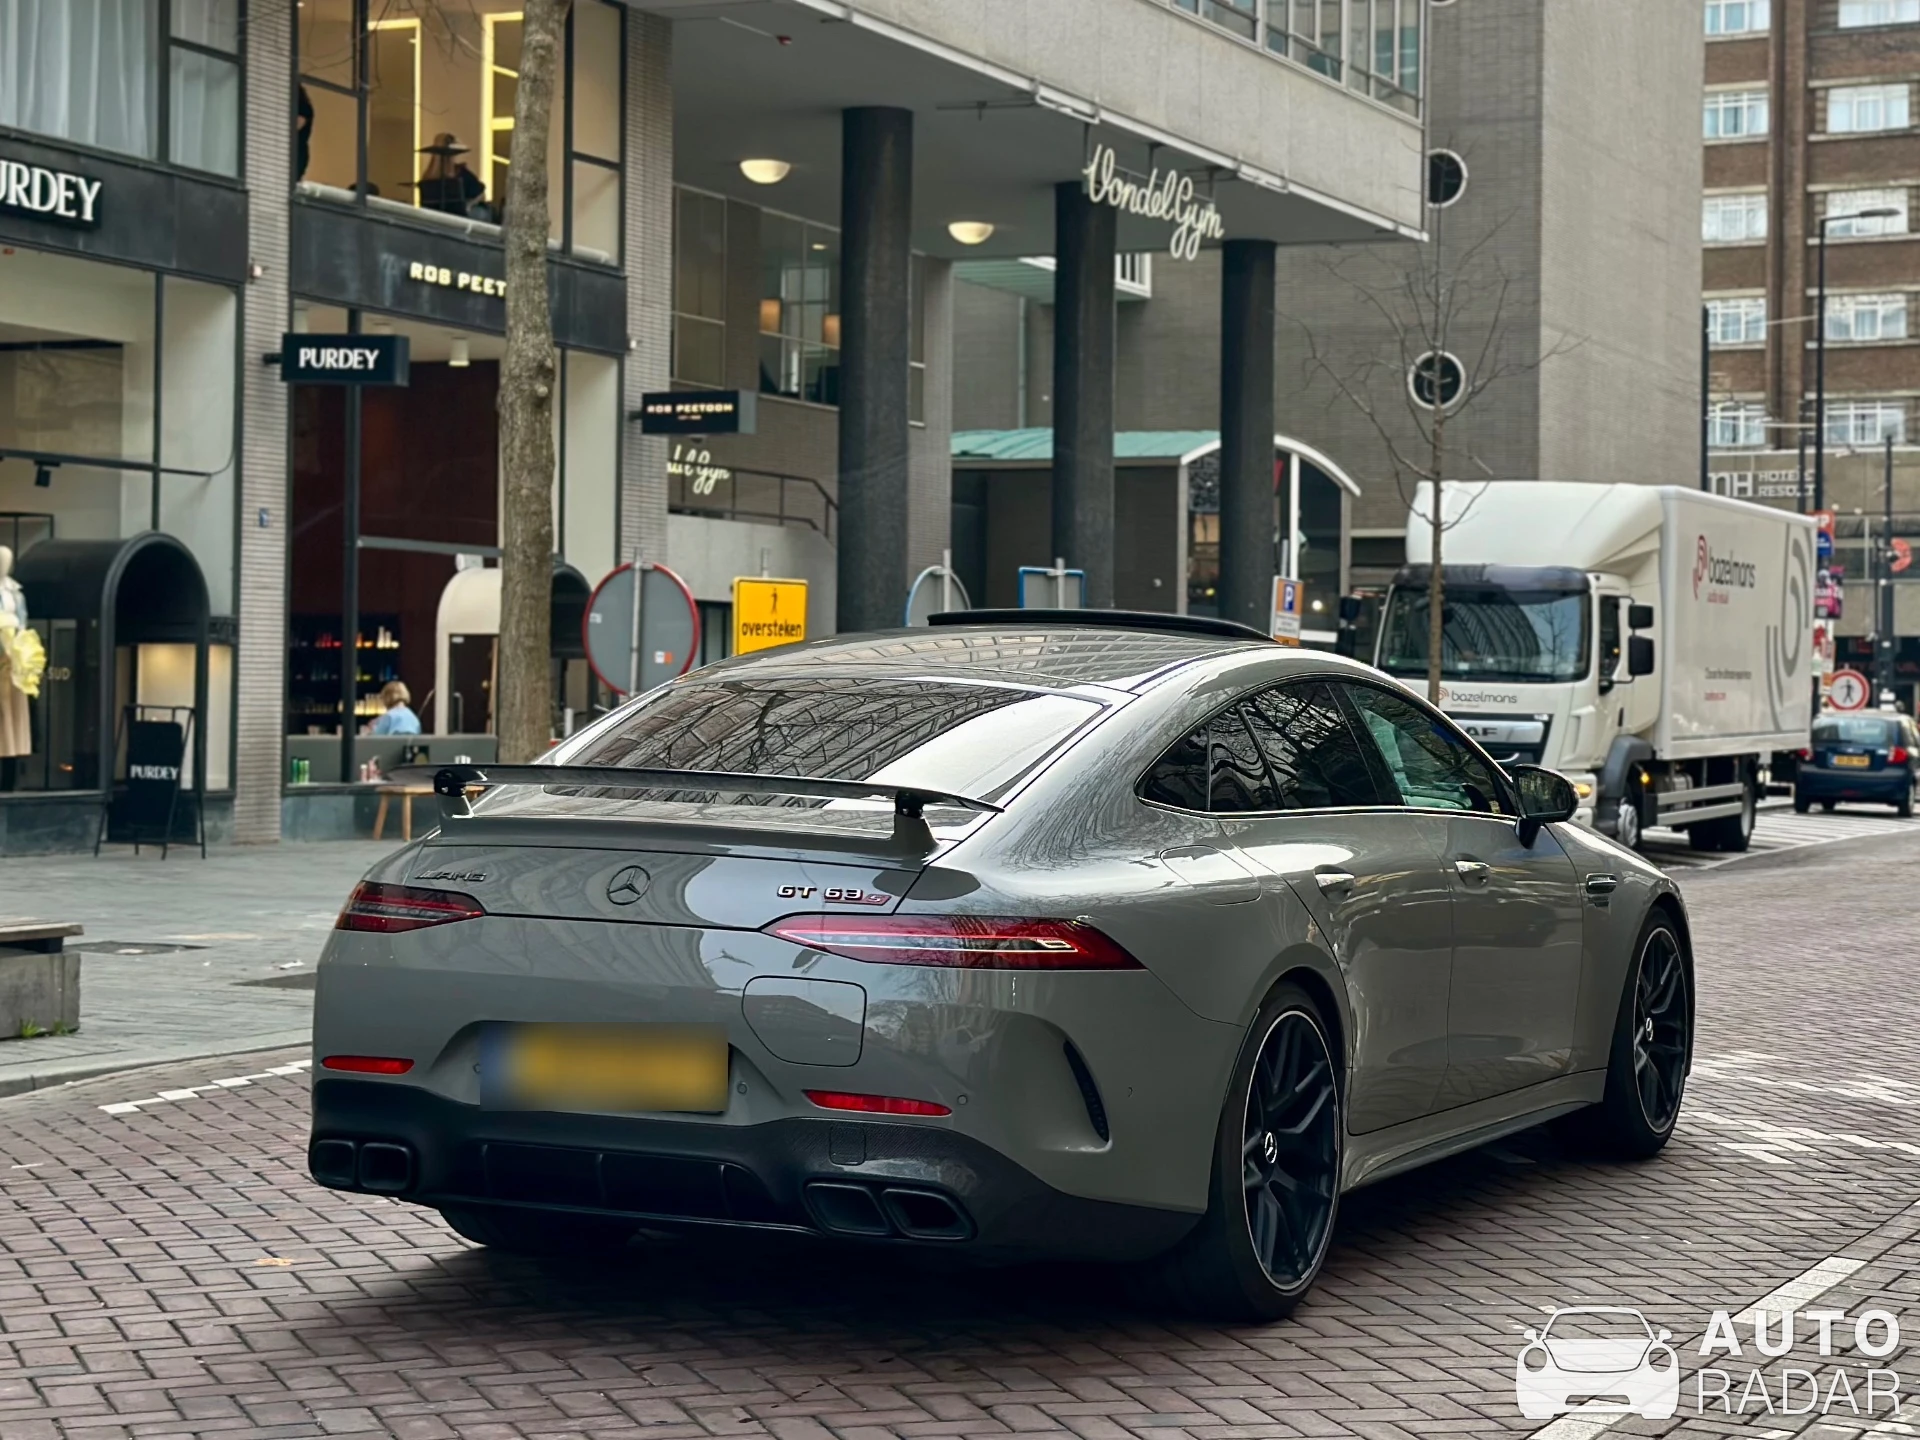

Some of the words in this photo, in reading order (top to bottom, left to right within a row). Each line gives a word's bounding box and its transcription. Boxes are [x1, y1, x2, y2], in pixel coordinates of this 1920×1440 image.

[1082, 144, 1225, 261] VondelGym
[409, 261, 451, 285] ROB
[298, 347, 379, 370] PURDEY
[647, 404, 672, 413] ROB
[676, 402, 733, 412] PEETOOM
[1759, 484, 1815, 497] RESOT
[1709, 546, 1755, 588] bazelmans
[742, 619, 803, 637] oversteken
[1451, 690, 1517, 704] bazelmans
[130, 764, 179, 780] PURDEY
[434, 871, 487, 882] AMG
[777, 885, 817, 898] GT
[824, 887, 863, 900] 63
